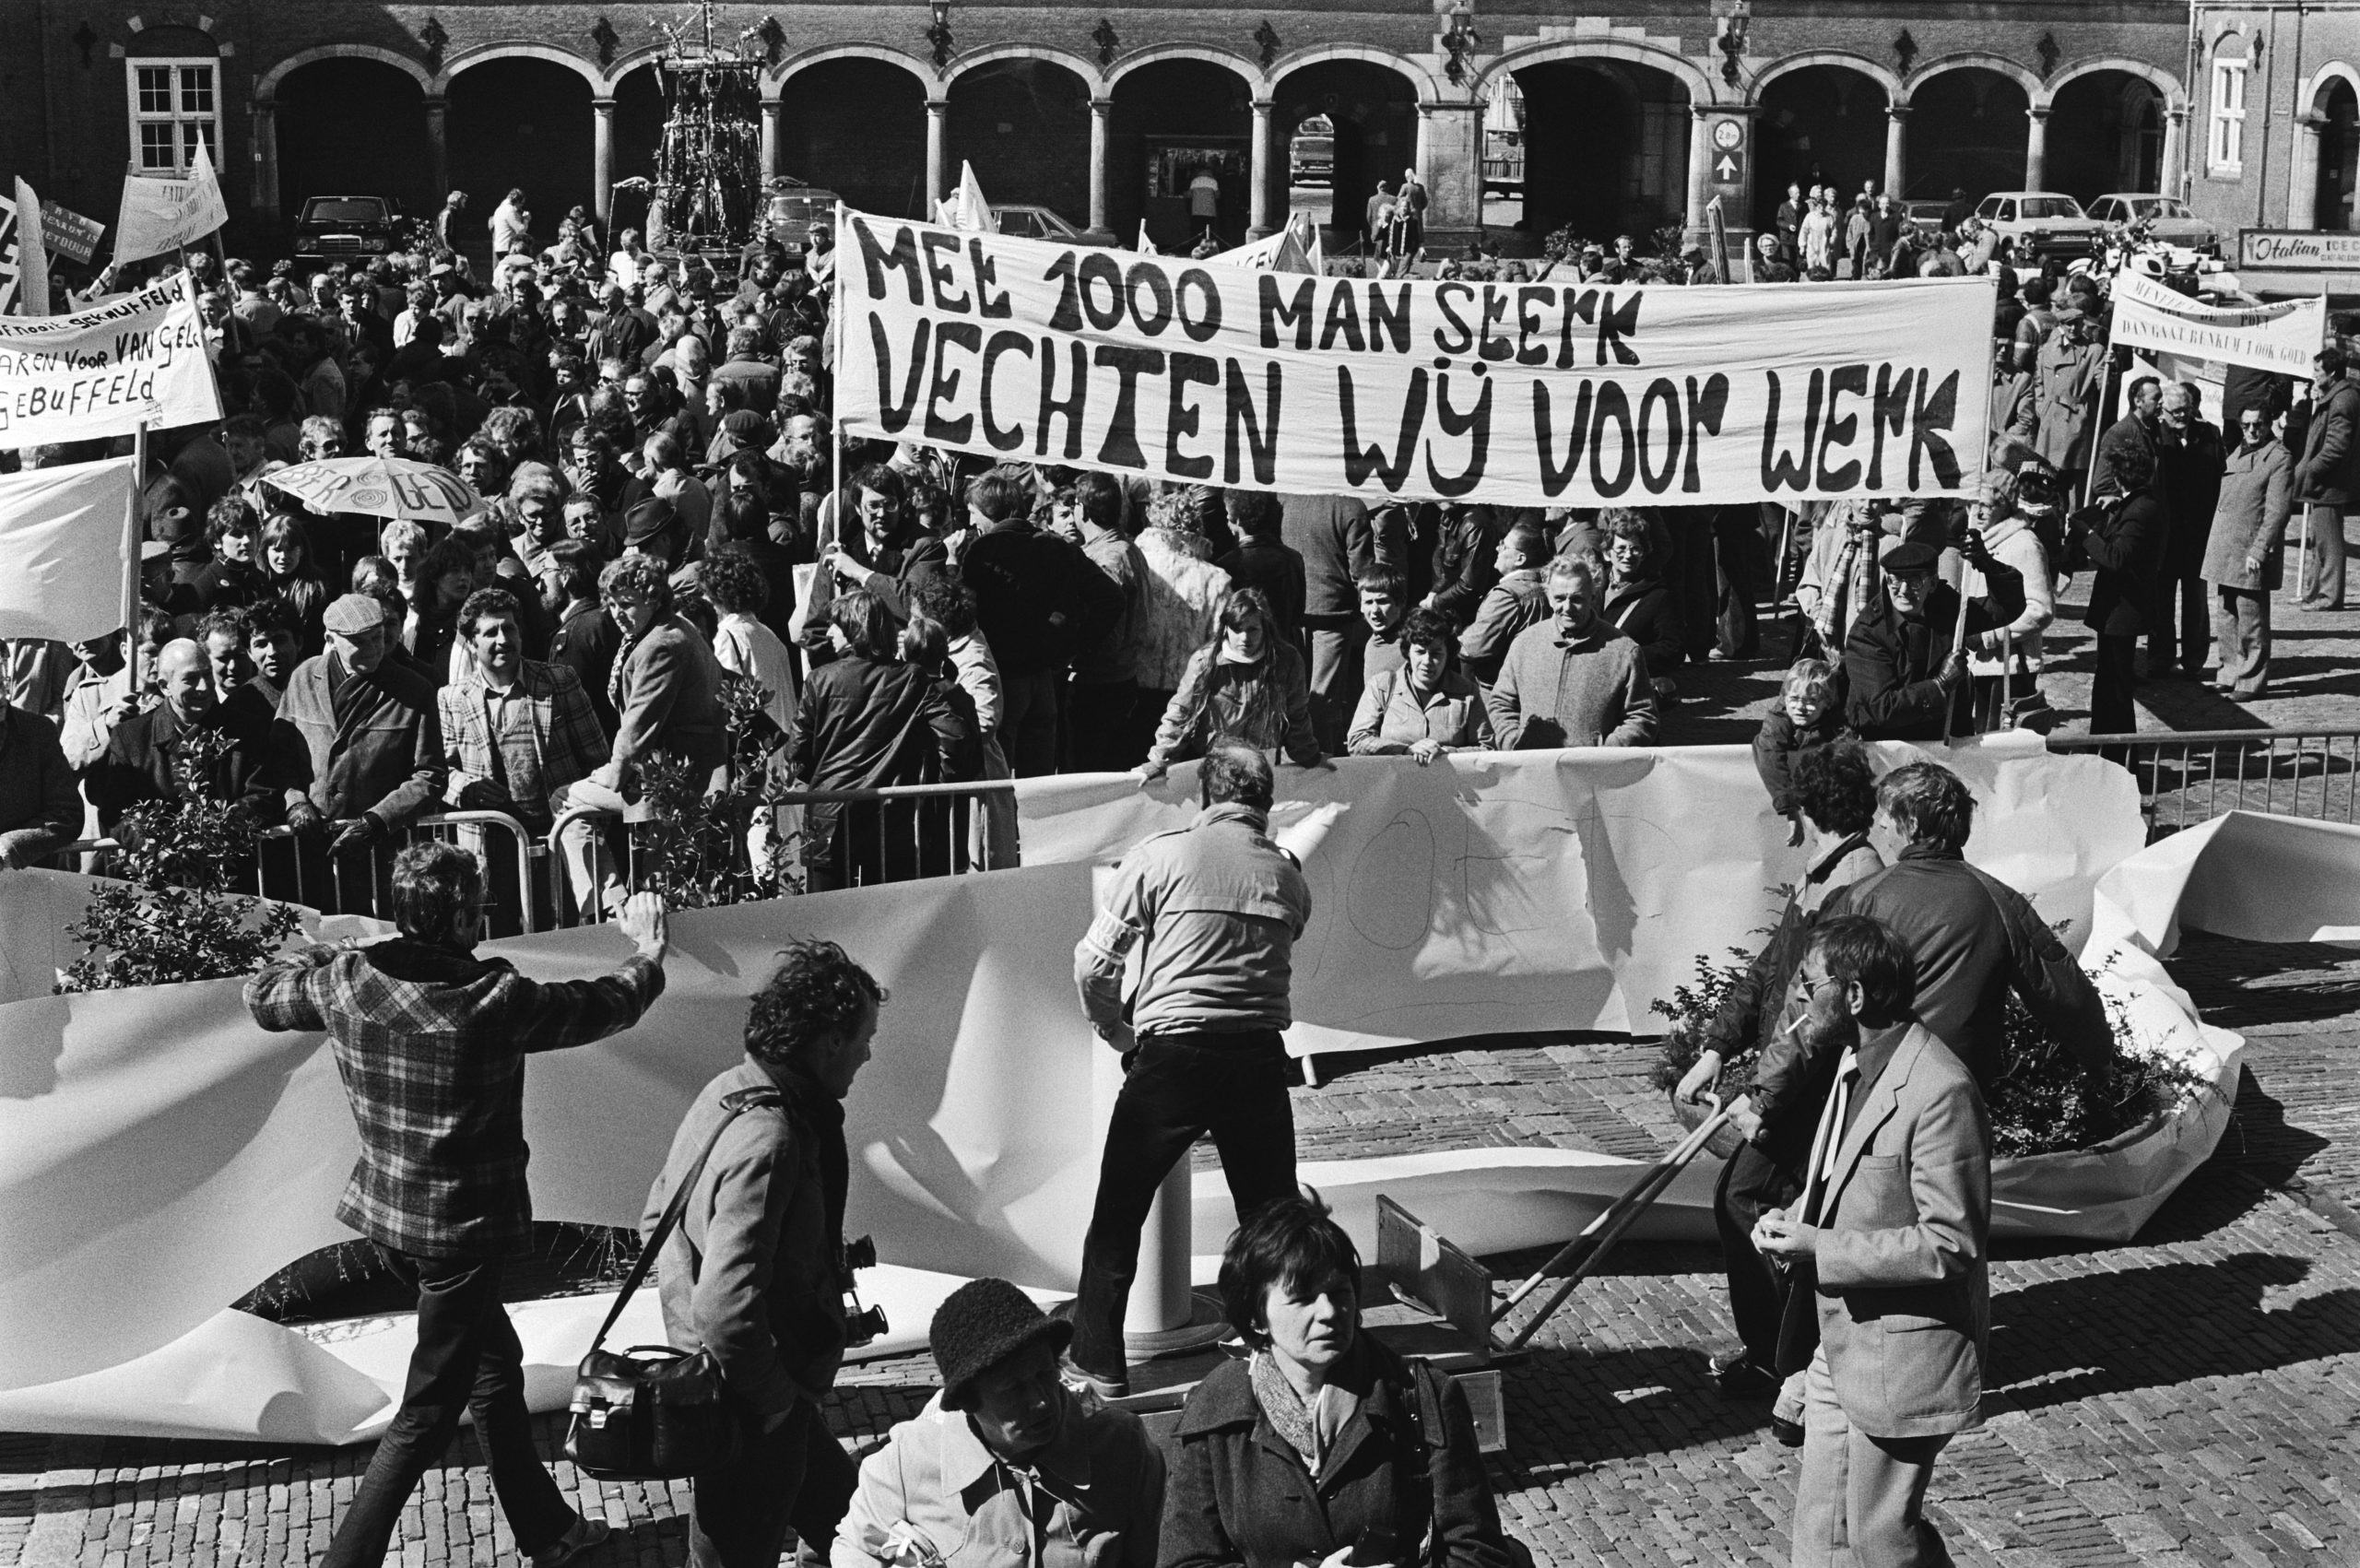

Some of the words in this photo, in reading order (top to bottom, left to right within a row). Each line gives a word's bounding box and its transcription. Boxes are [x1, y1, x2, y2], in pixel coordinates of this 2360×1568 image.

[2256, 238, 2320, 260] Italian
[2326, 241, 2348, 252] ICE
[1044, 251, 1222, 343] 1000
[1260, 275, 1411, 355] MAN
[116, 331, 154, 364] VAN
[869, 311, 1282, 485] VECHTEN
